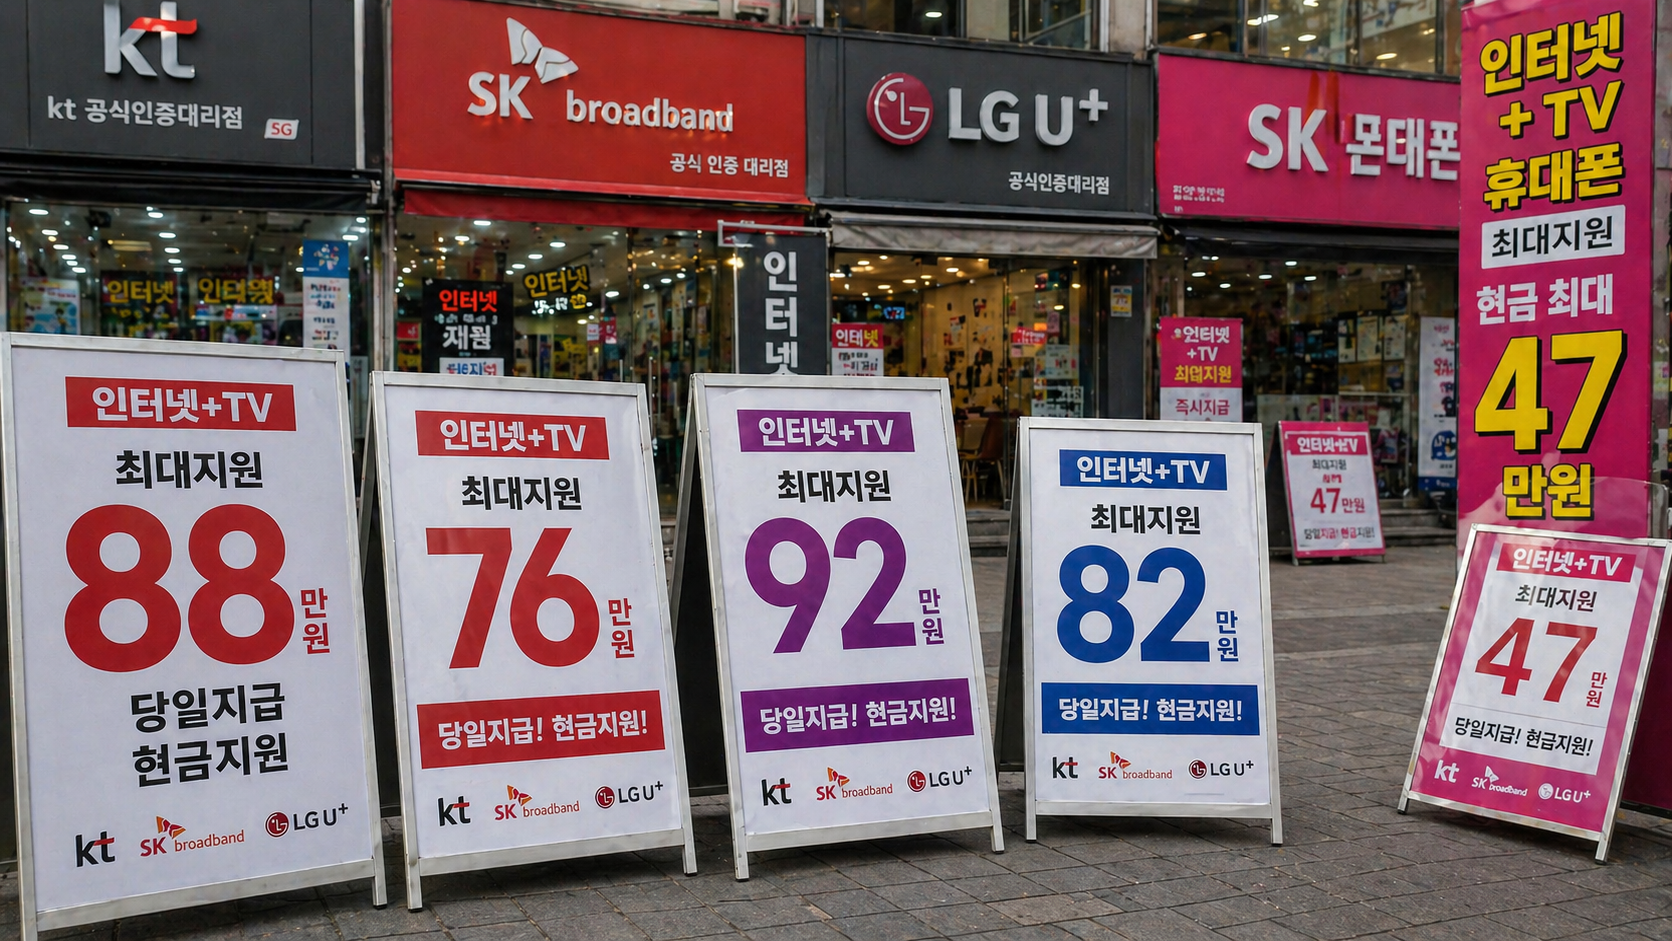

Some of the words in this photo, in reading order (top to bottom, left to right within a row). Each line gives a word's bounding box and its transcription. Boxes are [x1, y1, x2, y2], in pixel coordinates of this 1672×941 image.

[104, 0, 197, 79] kt
[1480, 12, 1623, 95] 인터넷
[47, 96, 77, 121] kt
[84, 98, 243, 130] 공식인증대리점
[467, 71, 533, 120] SK
[566, 89, 734, 133] broadband
[1500, 102, 1534, 138] +
[1543, 81, 1623, 138] TV
[949, 87, 1020, 143] LG
[1035, 88, 1108, 146] U+
[1247, 104, 1329, 172] SK
[670, 153, 701, 172] 공식
[707, 155, 738, 175] 인증
[744, 157, 789, 178] 대리점
[1008, 171, 1110, 195] 공식인증대리점
[1483, 143, 1625, 211] 휴대폰
[1492, 216, 1614, 259] 최대지원
[107, 280, 174, 304] 인터넷
[525, 265, 589, 298] 인터넷
[439, 289, 498, 312] 인터넷
[1477, 283, 1539, 325] 현금
[1548, 274, 1614, 318] 최대
[92, 386, 273, 423] 인터넷+TV
[1474, 330, 1627, 455] 47
[440, 420, 586, 452] 인터넷+TV
[758, 417, 894, 447] 인터넷+TV
[116, 450, 263, 489] 최대지원
[777, 470, 891, 502] 최대지원
[1076, 456, 1209, 484] 인터넷+TV
[462, 476, 582, 510] 최대지원
[1310, 487, 1341, 514] 47
[1502, 463, 1594, 520] 만원
[1091, 504, 1201, 534] 최대지원
[1513, 547, 1622, 576] 인터넷+TV
[64, 504, 295, 672] 88
[426, 527, 600, 668] 76
[745, 517, 917, 653] 92
[1515, 585, 1597, 612] 최대지원
[301, 587, 330, 654] 만원
[919, 588, 944, 645] 만원
[1057, 545, 1210, 663] 82
[608, 598, 635, 658] 만원
[1216, 610, 1239, 662] 만원
[1475, 617, 1598, 703] 47
[1586, 671, 1607, 708] 만원
[131, 682, 285, 733] 당일지급
[760, 704, 857, 735] 당일지급!
[866, 697, 956, 727] 현금지원!
[1059, 698, 1149, 721] 당일지급!
[1157, 699, 1243, 722] 현금지원!
[438, 717, 543, 750] 당일지급!
[552, 710, 648, 741] 현금지원!
[1454, 717, 1522, 744] 당일지급!
[1525, 729, 1594, 757] 현금지원!
[133, 733, 288, 787] 현금지원
[1052, 757, 1078, 779] kt
[1099, 767, 1118, 779] SK
[1123, 769, 1173, 779] broadband
[1211, 762, 1231, 777] LG
[1434, 759, 1460, 783] kt
[618, 786, 640, 803] LG
[761, 778, 791, 806] kt
[816, 785, 837, 800] SK
[842, 784, 893, 798] broadband
[929, 772, 950, 788] LG
[1471, 776, 1487, 790] SK
[1489, 783, 1528, 797] broadband
[1554, 788, 1571, 801] LG
[293, 811, 319, 830] LG
[438, 796, 470, 826] kt
[495, 804, 517, 820] SK
[523, 801, 580, 818] broadband
[75, 831, 115, 867] kt
[140, 836, 167, 857] SK
[175, 830, 245, 852] broadband
